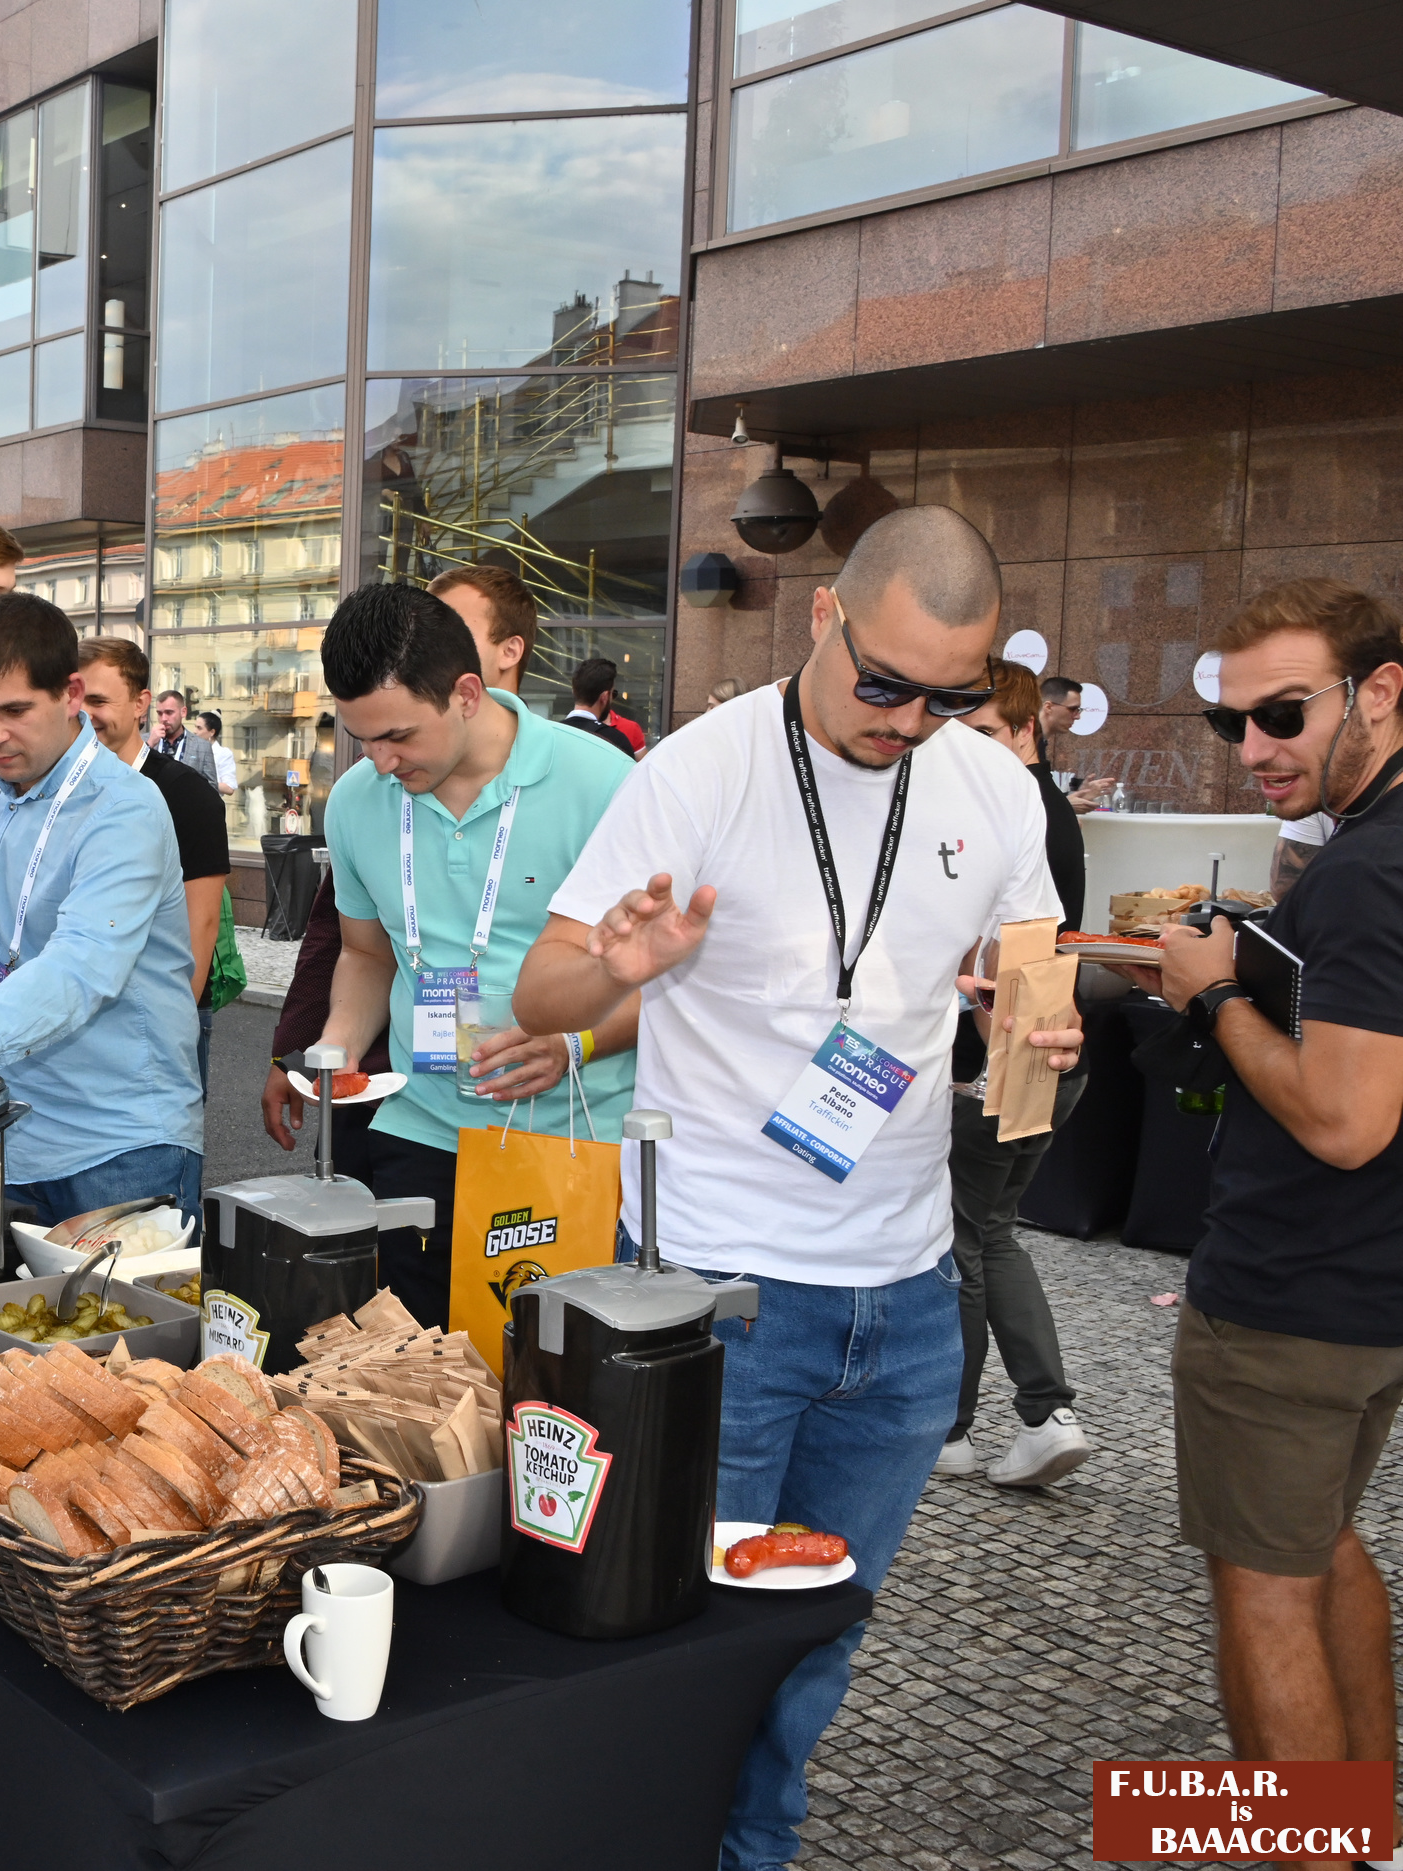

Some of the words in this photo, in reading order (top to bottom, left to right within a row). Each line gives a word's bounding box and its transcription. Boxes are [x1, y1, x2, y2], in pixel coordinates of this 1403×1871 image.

[1196, 671, 1220, 680] XLove
[493, 826, 505, 860] monneo
[482, 878, 494, 913] monneo
[409, 905, 418, 938] monneo
[423, 971, 434, 979] TES
[436, 977, 476, 985] PRAGUE
[422, 988, 456, 998] monne
[427, 1011, 456, 1019] Iskande
[432, 1030, 455, 1039] RajBet
[845, 1034, 860, 1049] TES
[430, 1064, 457, 1072] Gambling
[830, 1052, 887, 1095] monneo
[858, 1054, 908, 1090] PRAGUE
[866, 1049, 900, 1074] WELCOME
[819, 1093, 853, 1119] Albano
[829, 1086, 857, 1108] Pedro
[808, 1100, 853, 1132] Traffickin'
[772, 1115, 808, 1141] AFFILIATE
[809, 1139, 852, 1170] CORPORATE
[792, 1143, 817, 1164] Dating
[494, 1210, 529, 1227] GOLDEN
[486, 1218, 556, 1257] GOOSE
[211, 1304, 245, 1329] HEINZ
[208, 1328, 245, 1352] MUSTARD
[527, 1419, 576, 1450] HEINZ
[524, 1443, 578, 1474] TOMATO
[526, 1460, 575, 1486] KETCHUP
